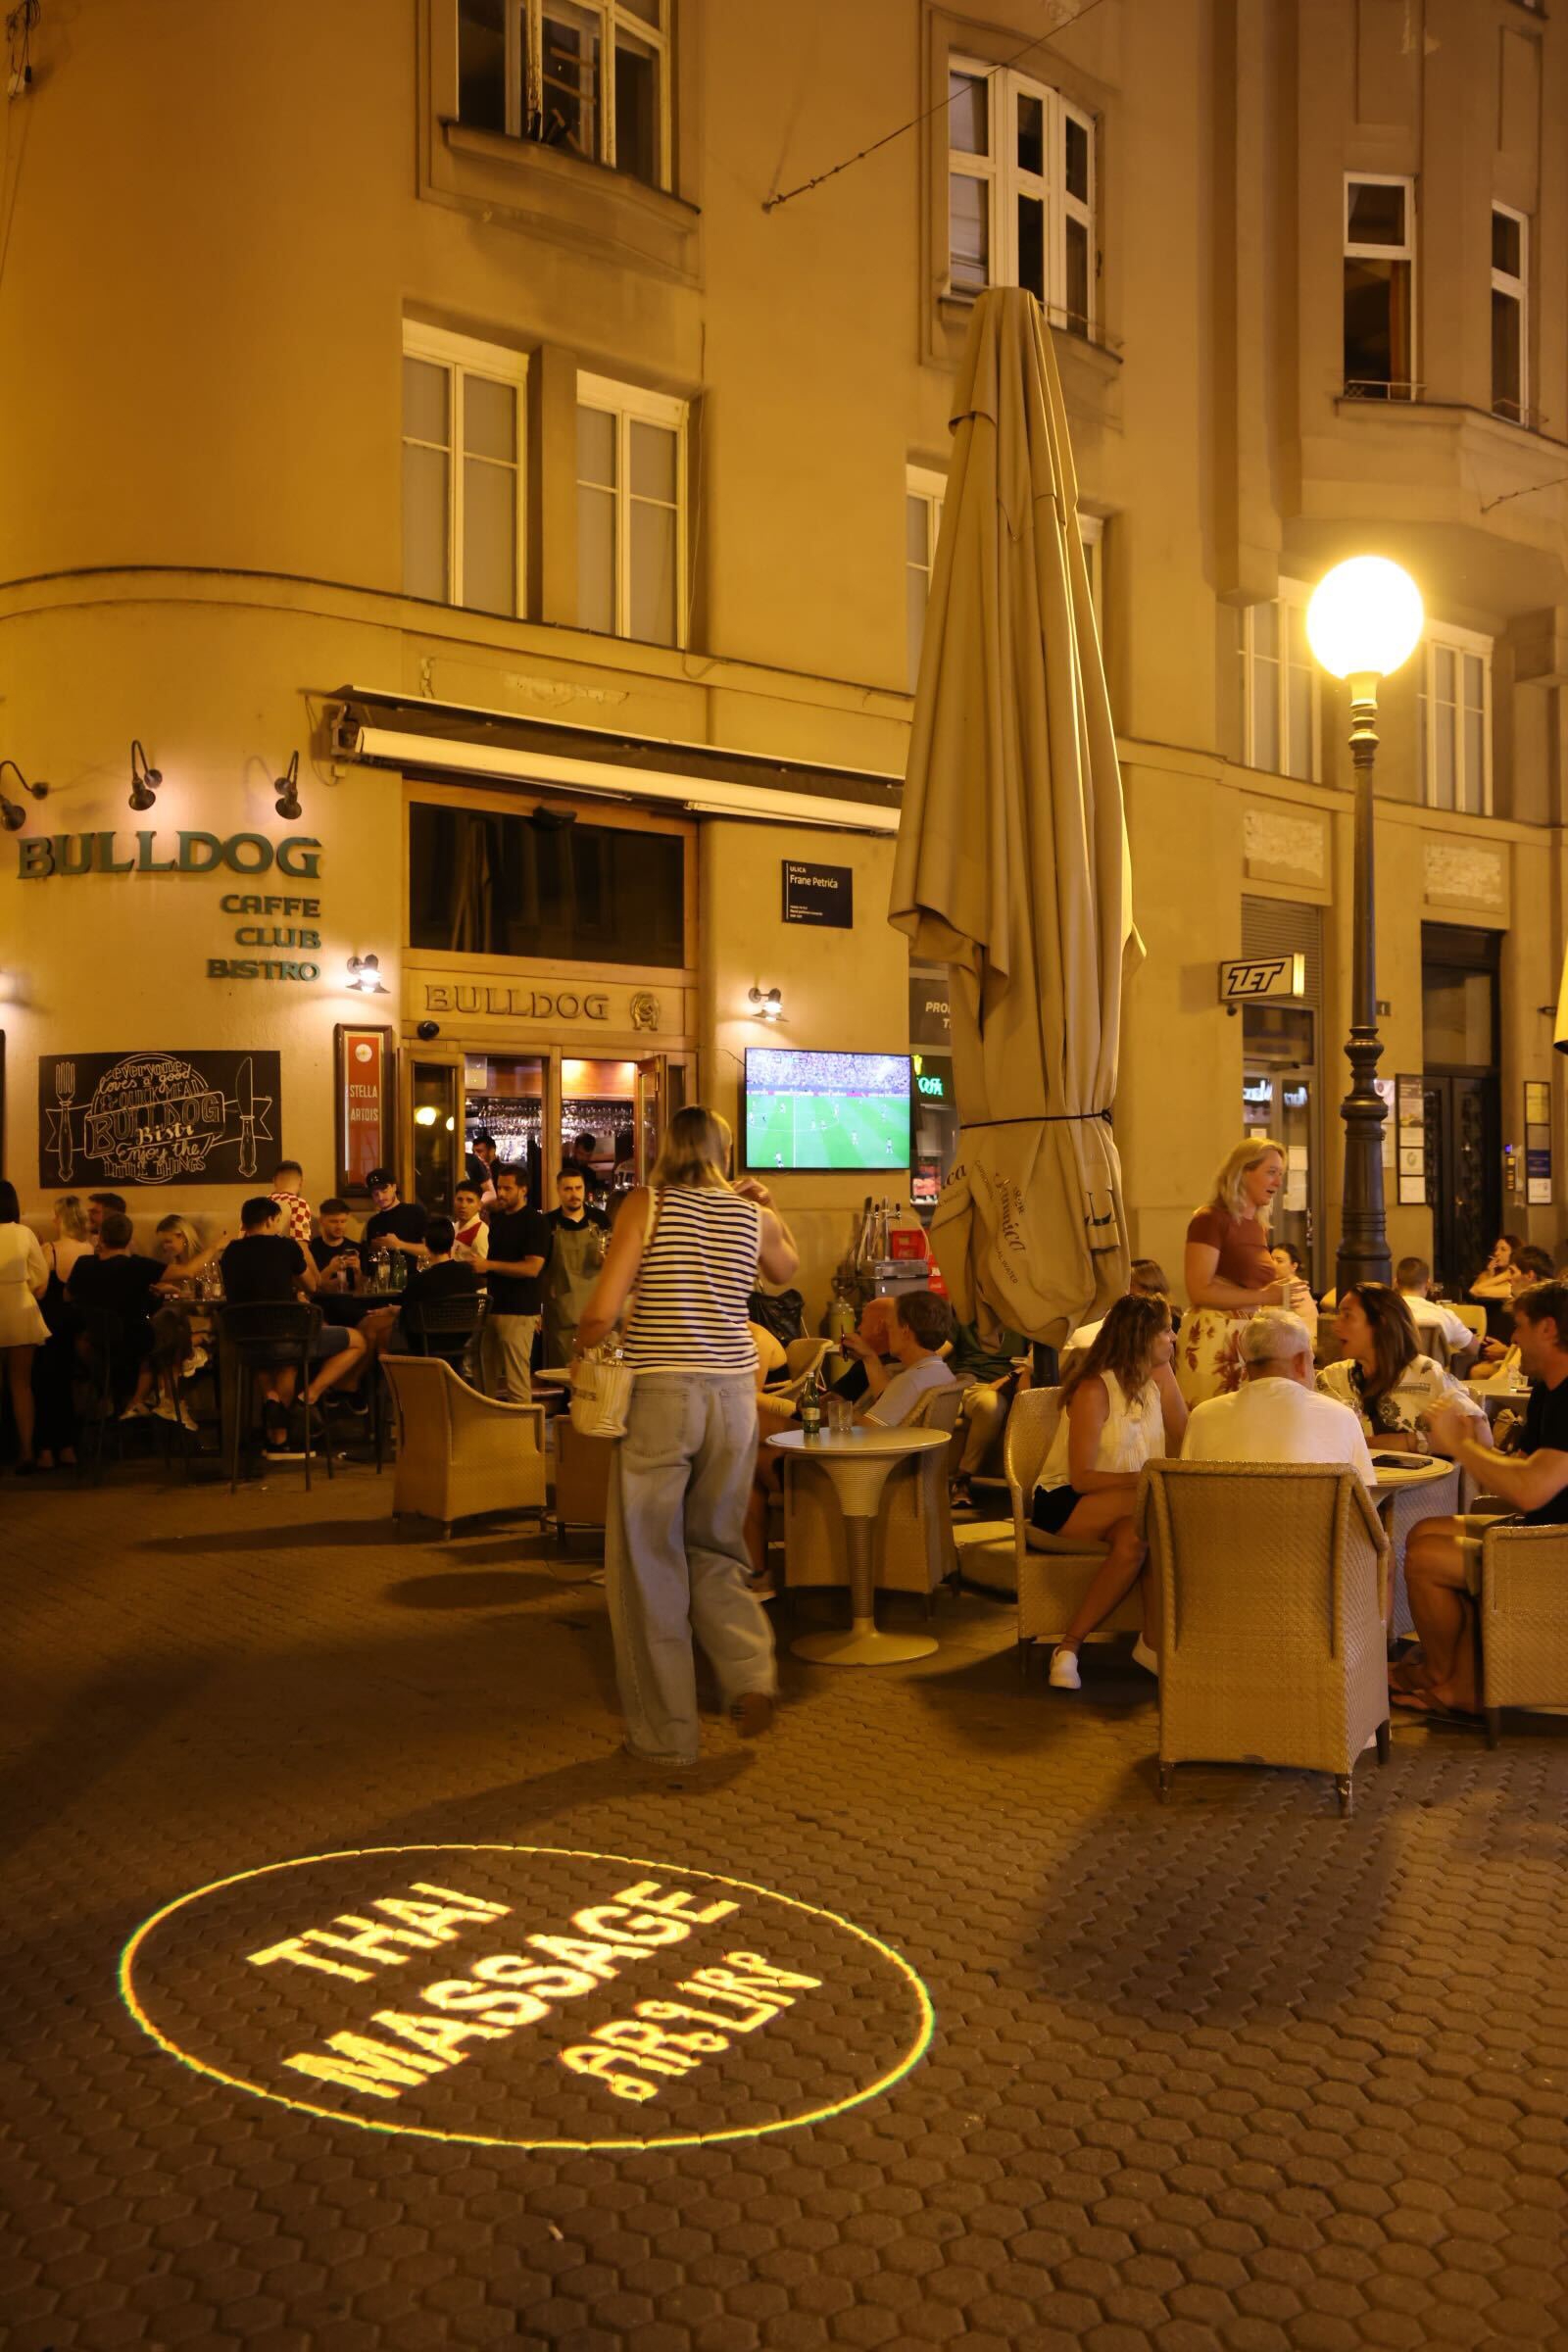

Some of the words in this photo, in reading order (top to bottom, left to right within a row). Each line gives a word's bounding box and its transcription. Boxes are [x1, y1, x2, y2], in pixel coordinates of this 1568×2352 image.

[17, 831, 321, 879] BULLDOG
[789, 865, 807, 874] ULICA
[789, 874, 811, 886] Frane
[220, 894, 321, 917] CAFFE
[235, 927, 321, 950] CLUB
[206, 958, 321, 981] BISTRO
[424, 984, 610, 1021] BULLDOG
[925, 1001, 951, 1014] PRO
[98, 1076, 138, 1095] loves
[159, 1063, 191, 1094] good
[112, 1060, 183, 1080] everyone
[349, 1084, 378, 1099] STELLA
[350, 1107, 379, 1122] ARTOIS
[116, 1142, 169, 1167] Enjoy
[172, 1140, 200, 1156] the
[245, 1881, 514, 1984] THAI
[281, 1880, 742, 2099] MASSAGE
